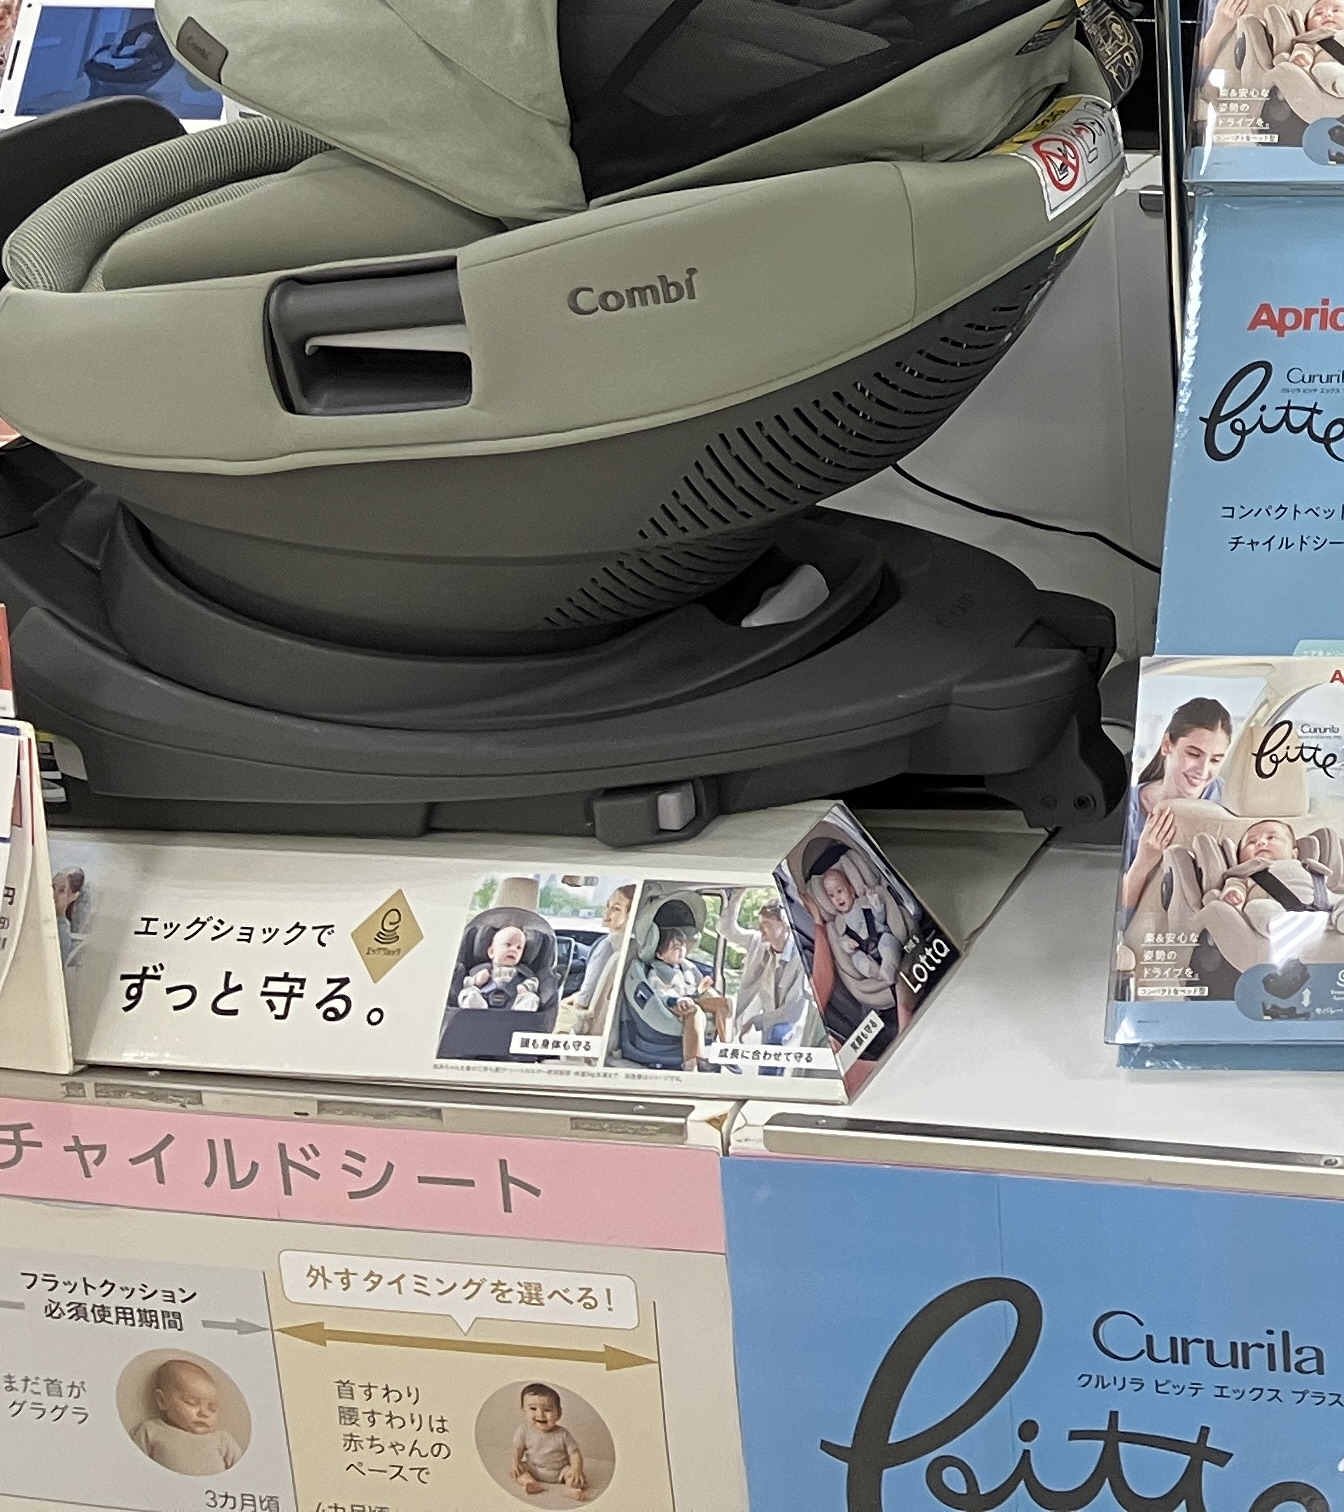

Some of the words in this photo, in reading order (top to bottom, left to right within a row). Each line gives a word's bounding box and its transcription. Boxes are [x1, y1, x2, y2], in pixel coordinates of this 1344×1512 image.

[566, 267, 699, 318] Combi
[133, 913, 338, 950] エッグショックで
[117, 965, 388, 1028] ずっと守る。
[718, 1048, 813, 1064] 成長に合わせて守る
[0, 1121, 542, 1214] チャイルドシート
[20, 1270, 198, 1306] フラットクッション
[306, 1264, 615, 1313] 外すタイミングを選べる!
[44, 1300, 185, 1333] 必須使用期間
[1092, 1308, 1327, 1378] Cururila
[334, 1380, 422, 1406] 首すわり
[1077, 1372, 1147, 1394] クルリラ
[1153, 1378, 1206, 1400] ビッテ
[1213, 1384, 1284, 1406] エックス
[8, 1400, 90, 1426] グラグラ
[338, 1406, 451, 1434] 腰すわりは
[342, 1434, 452, 1462] 赤ちゃんの
[346, 1461, 431, 1485] ペースで
